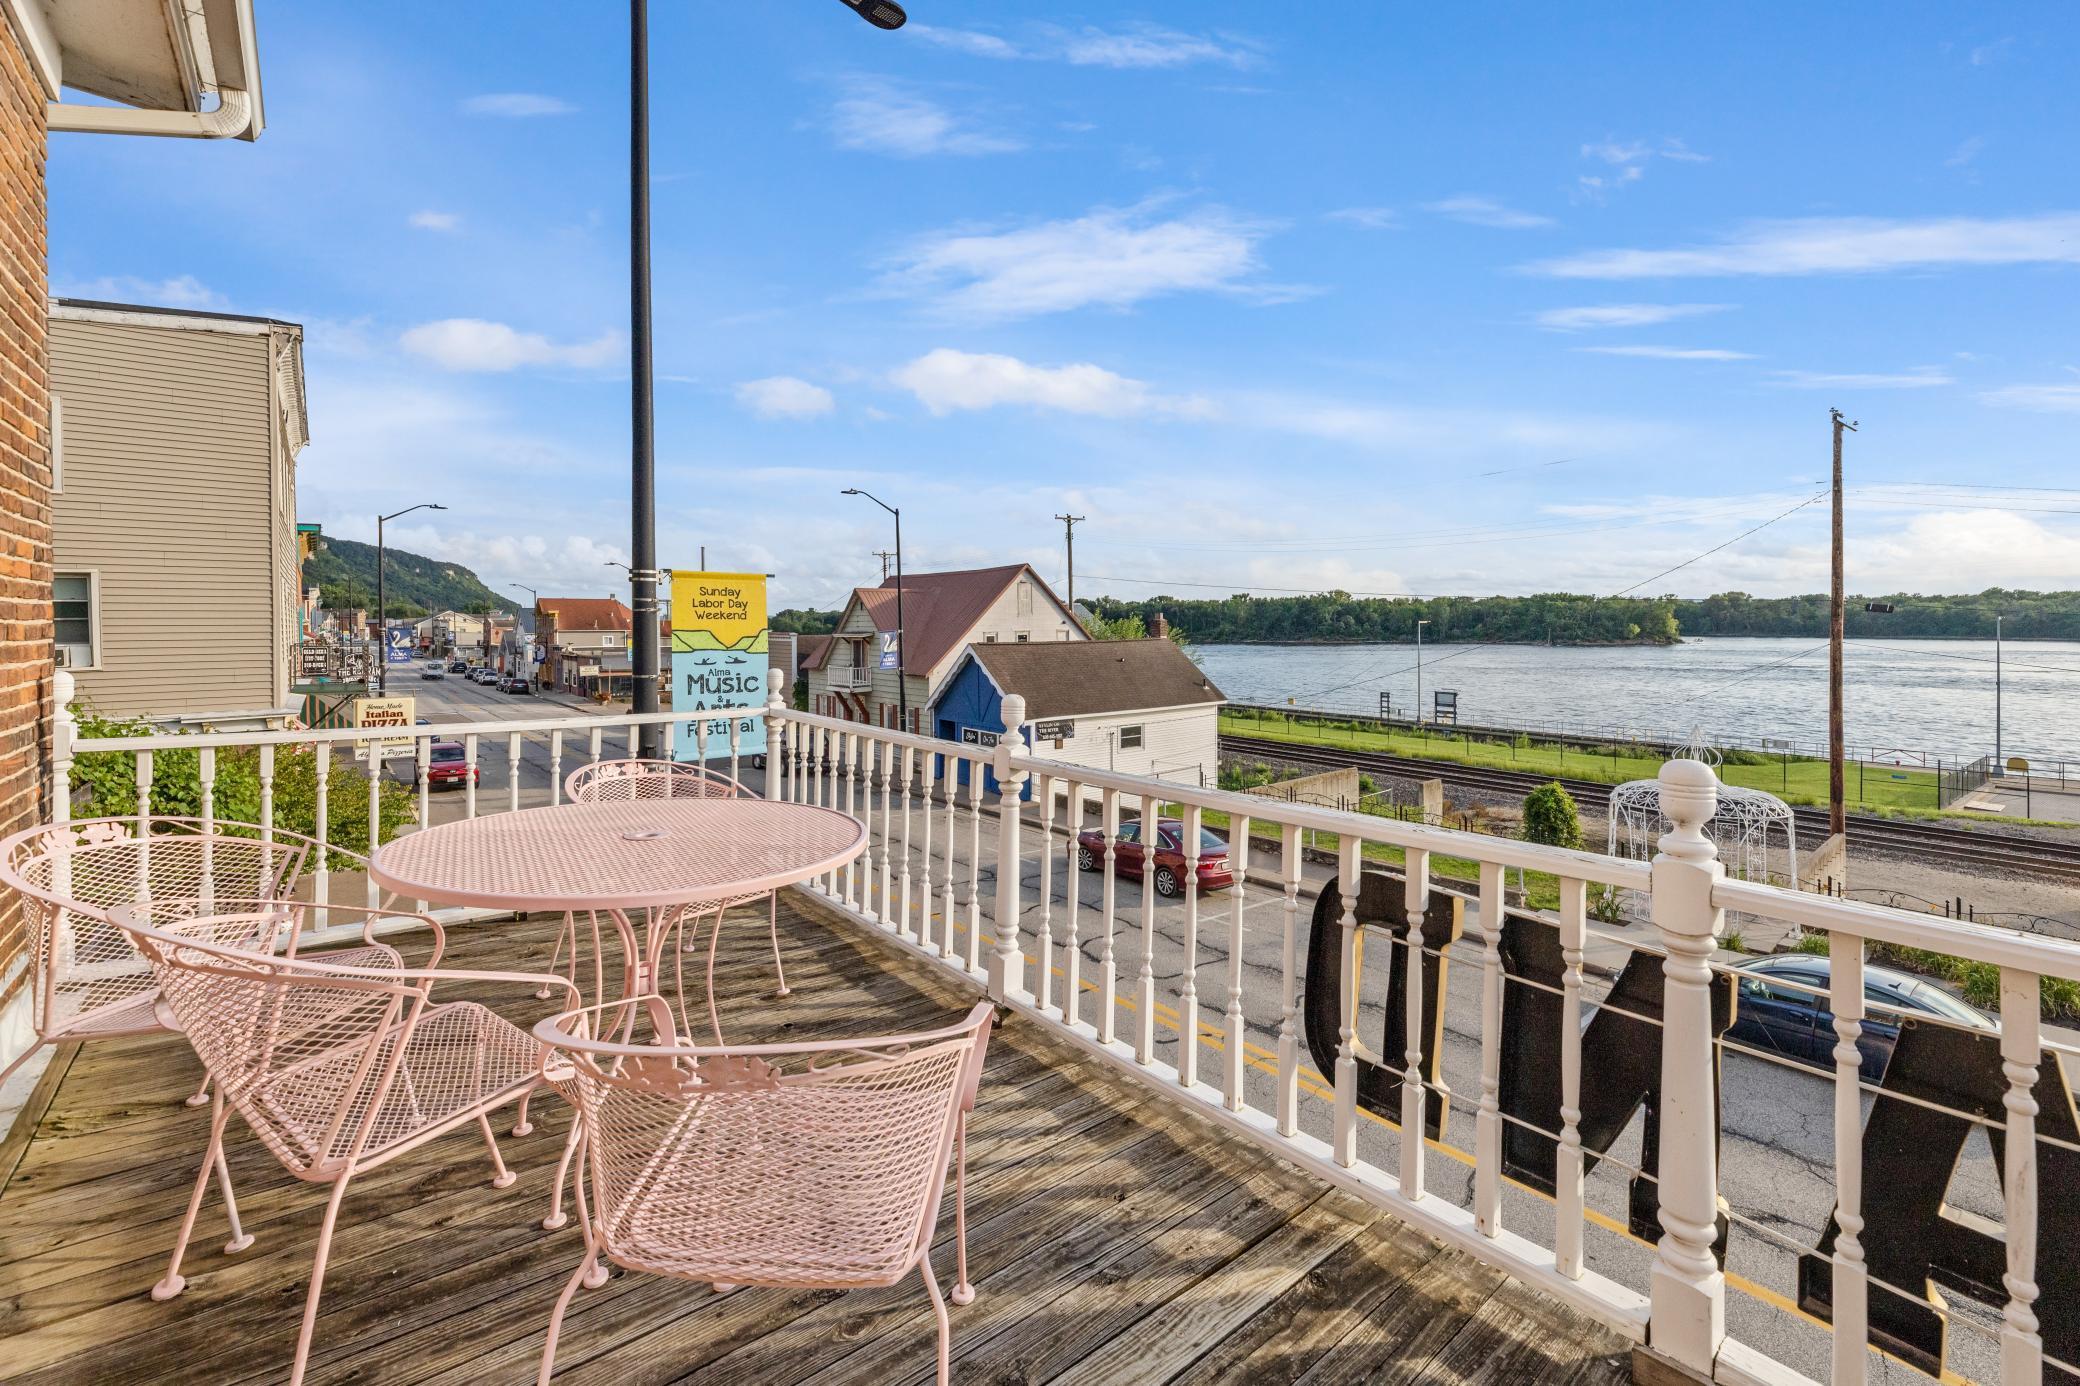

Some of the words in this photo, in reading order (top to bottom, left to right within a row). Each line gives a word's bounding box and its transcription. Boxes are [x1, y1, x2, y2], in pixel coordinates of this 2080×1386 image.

[699, 586, 741, 599] Sunday
[692, 598, 725, 608] Labor
[728, 598, 748, 611] Day
[694, 610, 747, 620] Weekend
[707, 668, 731, 677] Alma
[687, 673, 760, 695] Music
[717, 695, 724, 703] &
[365, 710, 403, 719] Italian
[687, 719, 755, 738] Fstial
